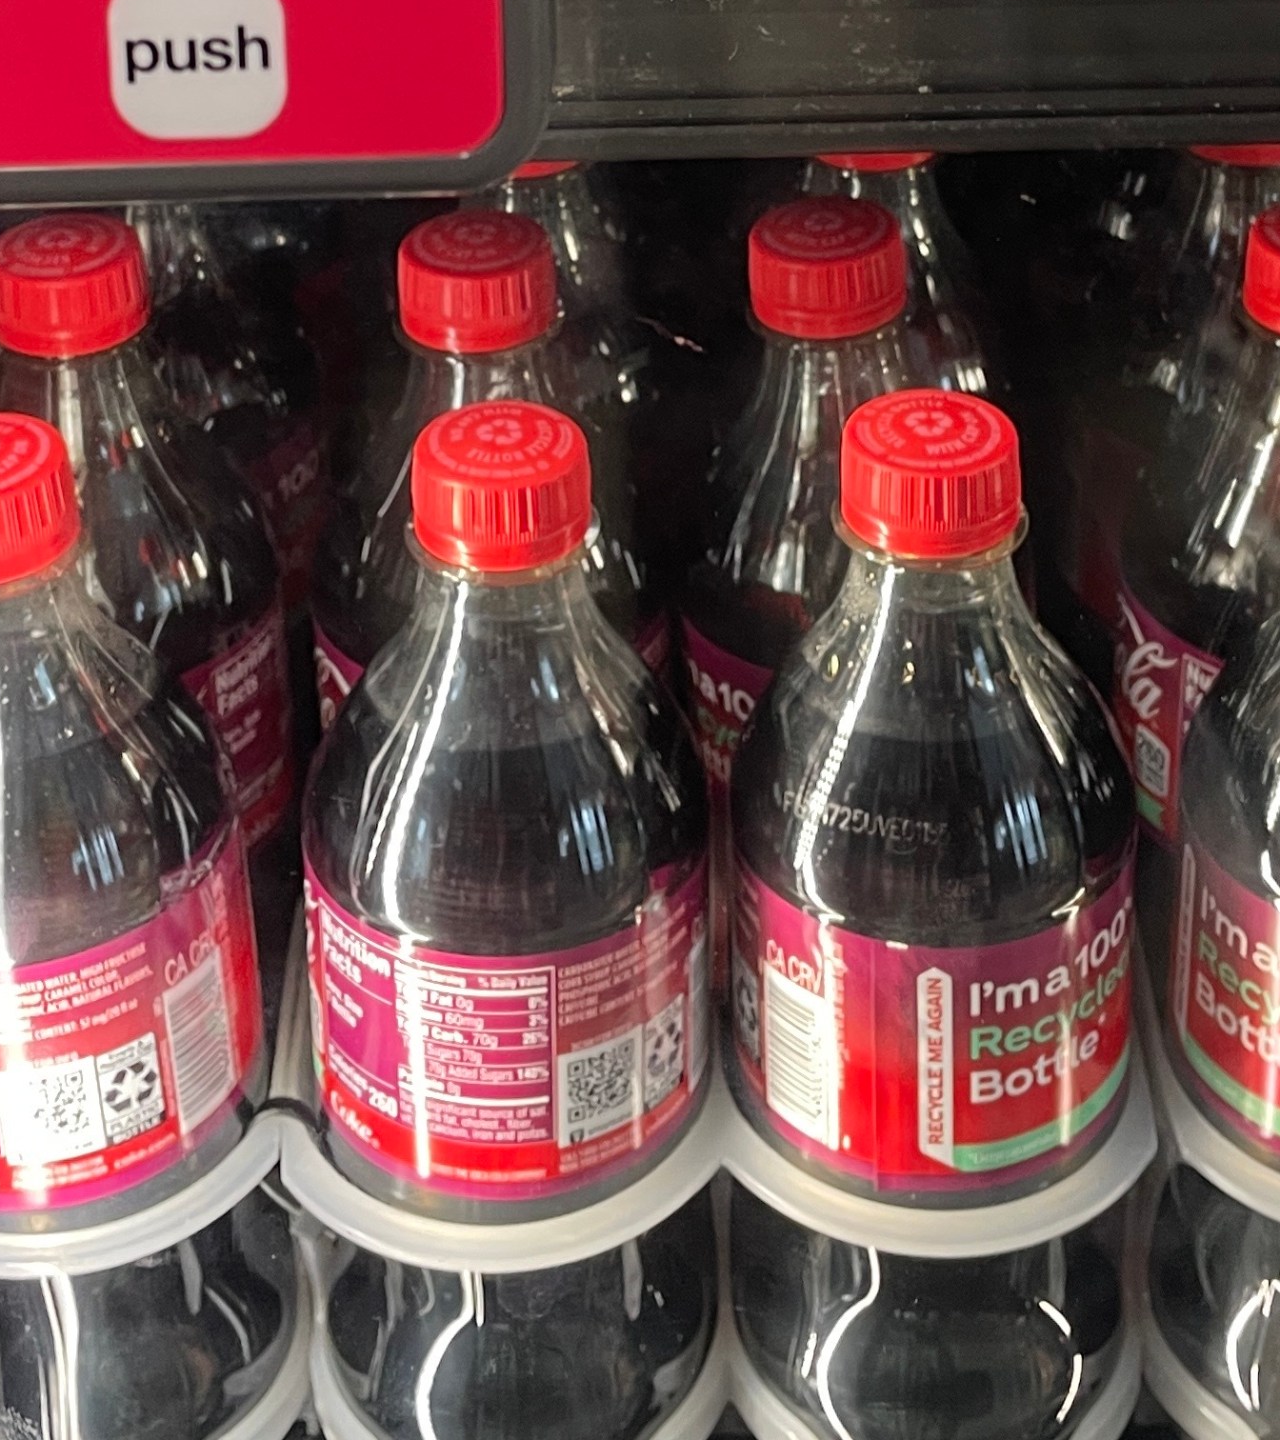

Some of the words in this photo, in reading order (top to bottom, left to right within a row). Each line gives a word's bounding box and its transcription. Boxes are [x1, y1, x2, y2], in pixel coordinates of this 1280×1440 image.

[124, 24, 271, 84] push
[1201, 885, 1249, 957] I'm
[1252, 940, 1280, 974] a
[765, 939, 788, 980] CA
[429, 991, 453, 1008] Fat
[929, 977, 943, 1031] AGAIN
[969, 974, 1039, 1018] I'm
[1045, 965, 1071, 996] a
[929, 1033, 944, 1063] ME
[928, 1067, 945, 1146] RECYCLE
